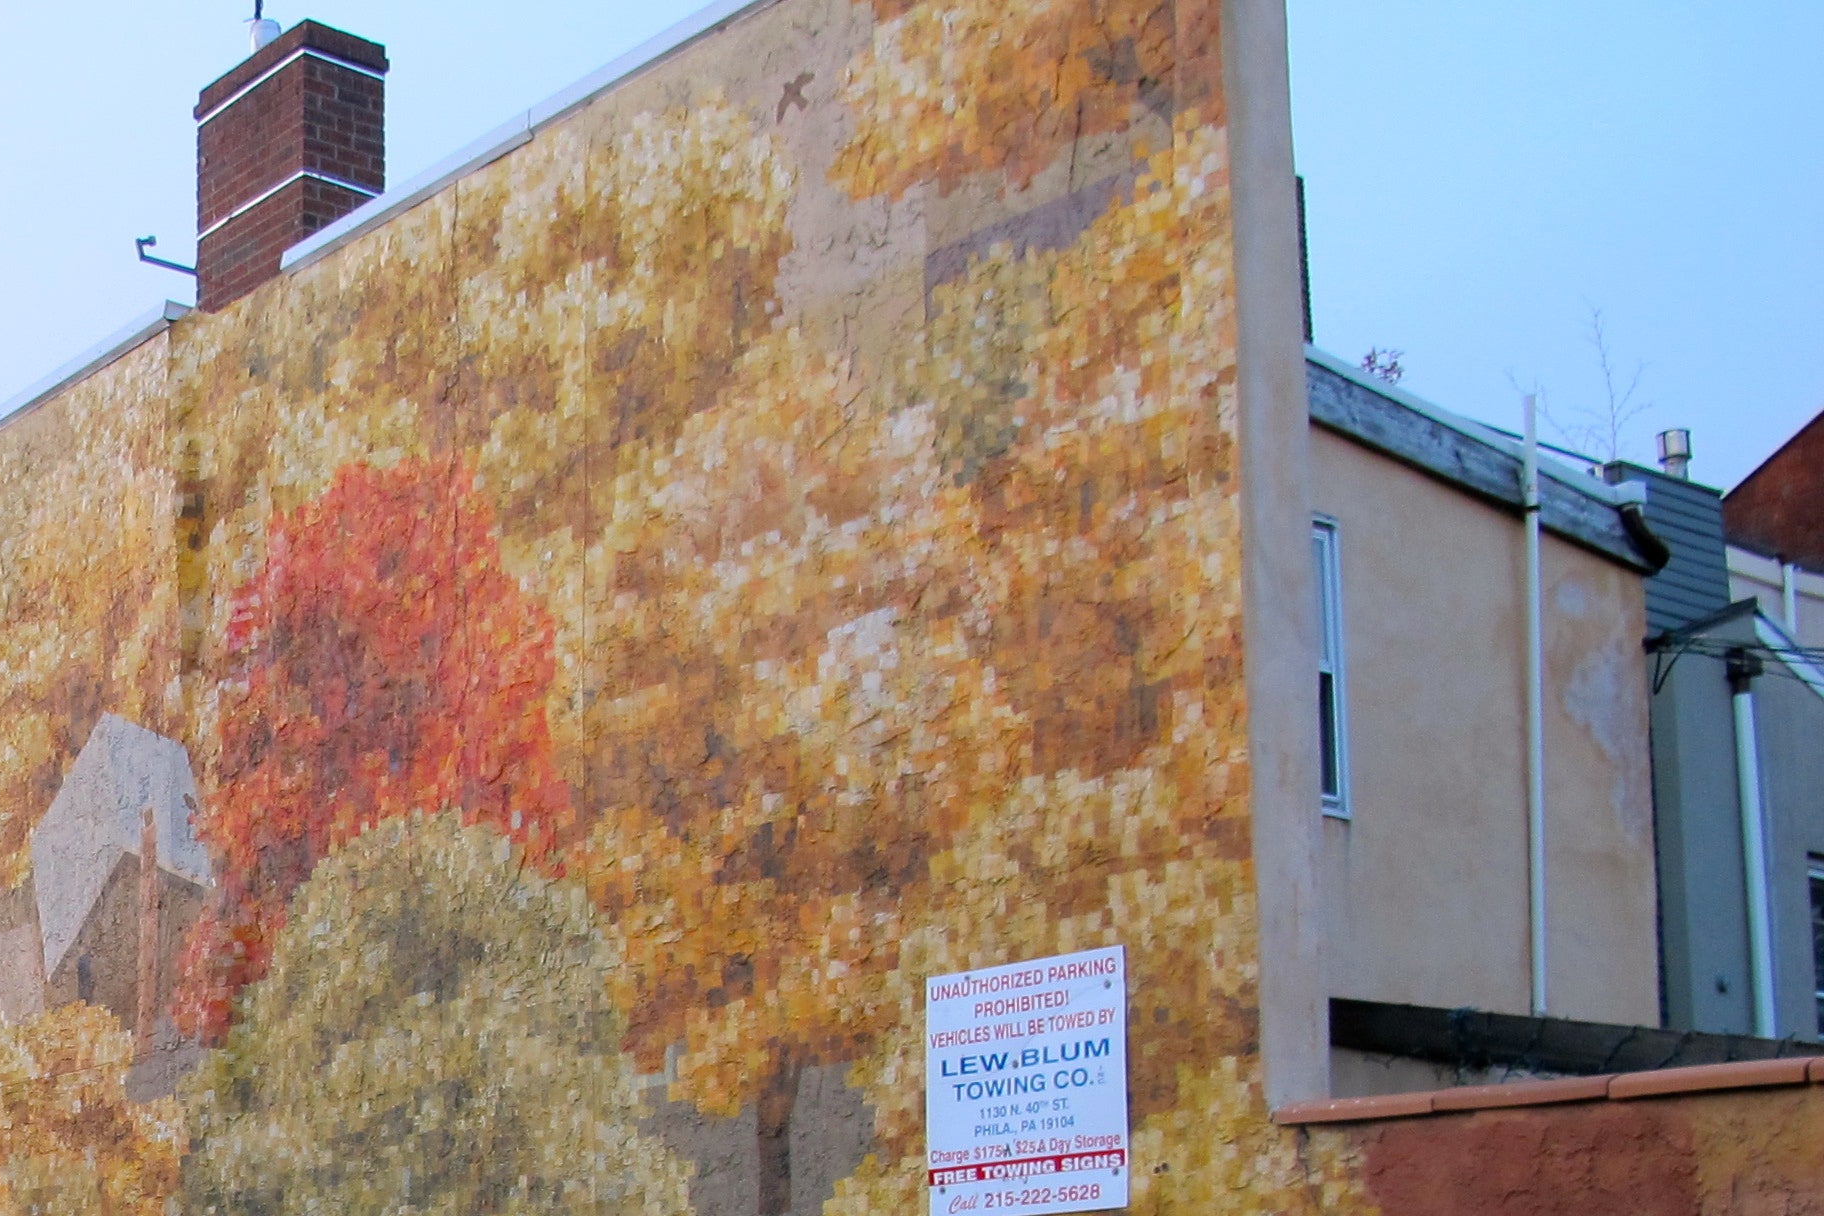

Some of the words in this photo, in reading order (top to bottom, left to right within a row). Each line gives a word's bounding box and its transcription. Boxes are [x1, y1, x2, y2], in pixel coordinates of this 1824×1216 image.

[930, 969, 1044, 1001] UNAUTHORIZED
[1047, 957, 1116, 983] PARKING
[974, 989, 1069, 1018] PROHIBITED!
[930, 1026, 991, 1049] VEHICLES
[994, 1022, 1025, 1040] WILL
[1027, 1020, 1045, 1036] BE
[1047, 1010, 1095, 1032] TOWED
[1098, 1007, 1116, 1025] BY
[941, 1052, 1009, 1077] LEW
[1020, 1038, 1110, 1067] BLUM
[953, 1073, 1045, 1101] TOWING
[1053, 1067, 1094, 1089] CO.
[979, 1106, 1007, 1119] 1130
[1010, 1104, 1022, 1116] N.
[1052, 1098, 1069, 1111] ST.
[1021, 1120, 1037, 1132] PA
[1041, 1116, 1075, 1130] 19104
[930, 1149, 970, 1164] Charge
[1049, 1137, 1072, 1154] Day
[1075, 1132, 1121, 1150] Storage
[933, 1169, 978, 1185] FREE
[982, 1160, 1056, 1179] TOWING
[1061, 1153, 1121, 1172] SIGNS
[948, 1193, 978, 1215] Call
[984, 1183, 1101, 1209] 215-222-5628
